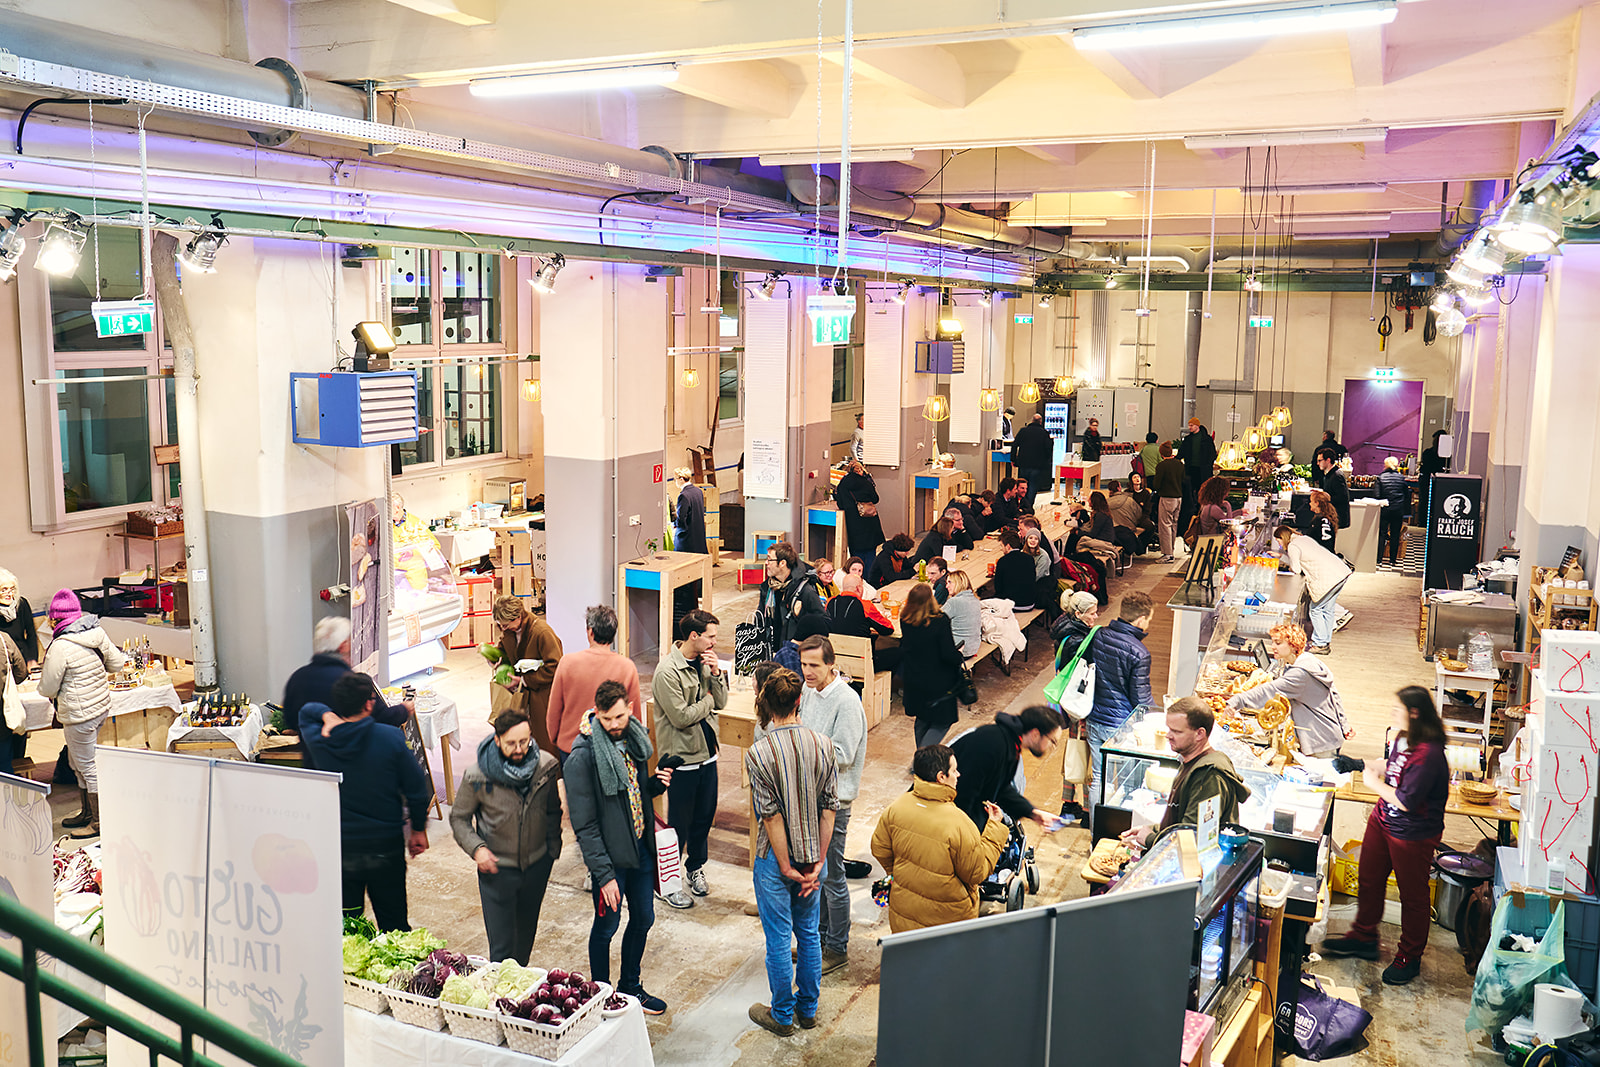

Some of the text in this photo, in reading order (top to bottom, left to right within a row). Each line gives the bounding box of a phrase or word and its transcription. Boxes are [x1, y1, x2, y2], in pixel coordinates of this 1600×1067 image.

[1456, 518, 1475, 526] JOSEF
[1437, 523, 1474, 536] RAUCH
[658, 840, 680, 883] STEFFL
